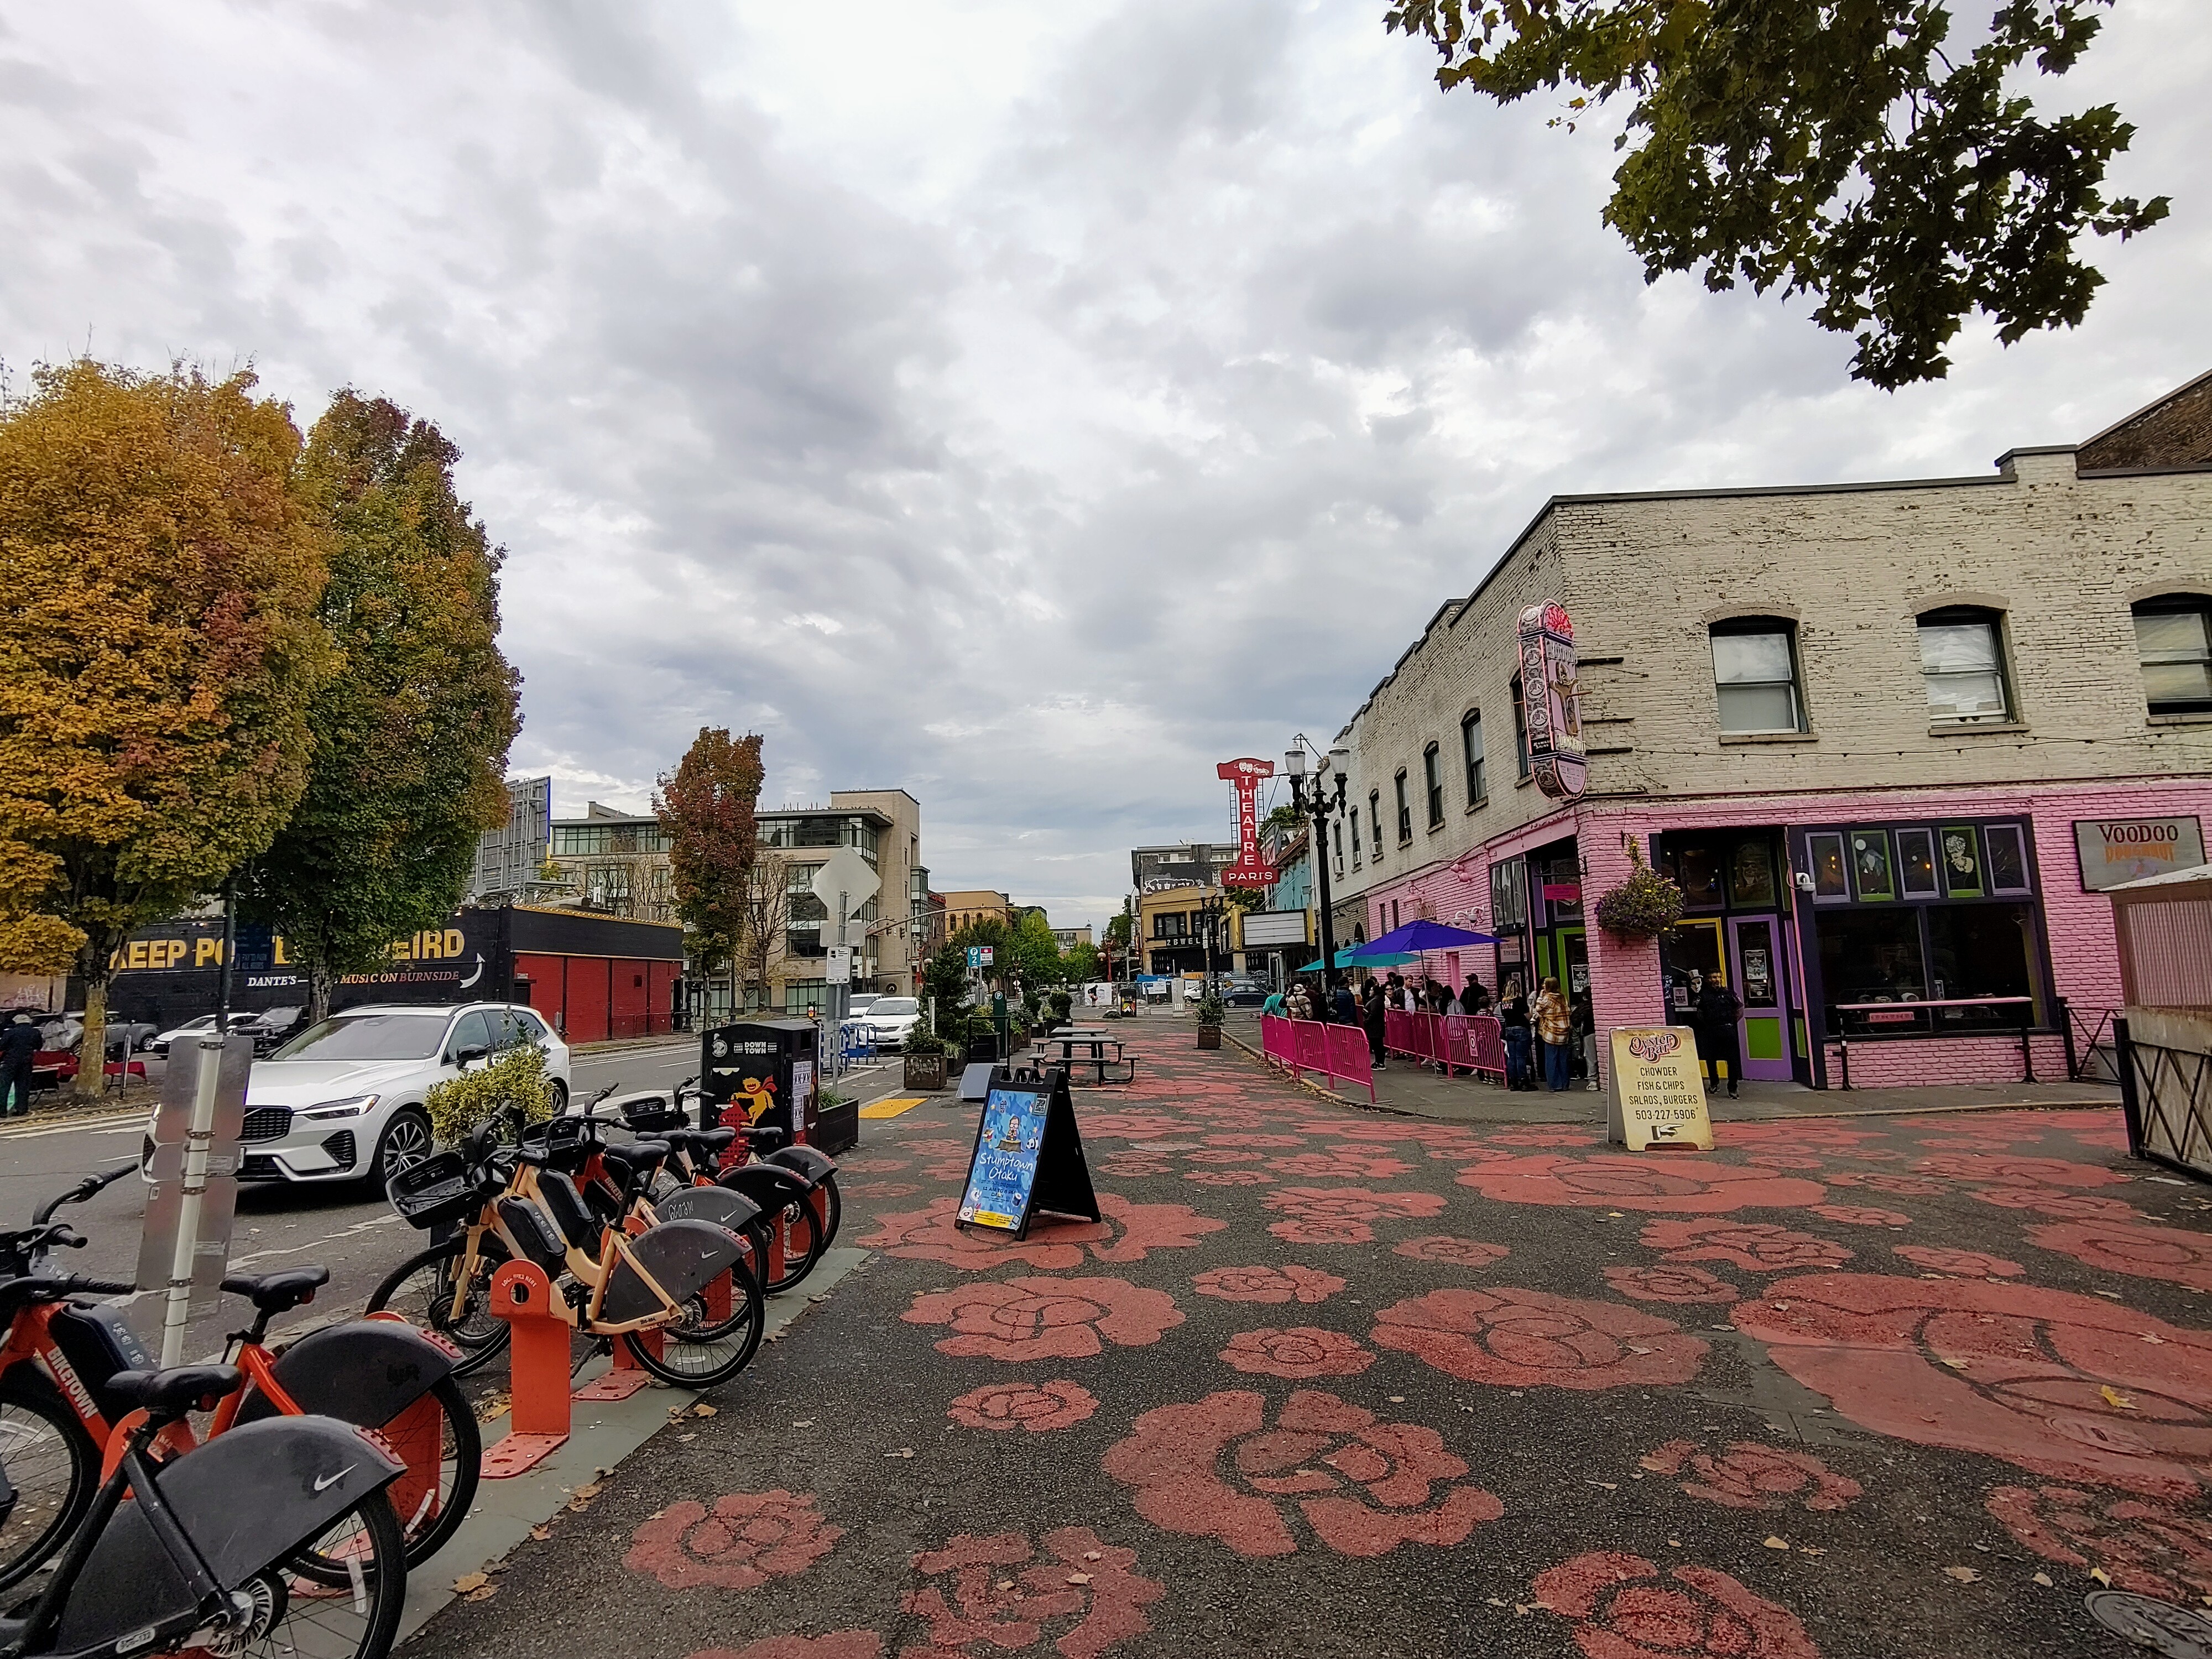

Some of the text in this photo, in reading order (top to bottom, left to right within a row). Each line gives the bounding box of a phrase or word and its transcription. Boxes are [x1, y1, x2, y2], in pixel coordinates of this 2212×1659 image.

[1241, 775, 1255, 866] THEATRE
[2096, 823, 2179, 844] VOODOO
[2105, 843, 2175, 864] DOUGHNUT
[1228, 871, 1273, 881] PARIS
[247, 971, 460, 987] DANTE'S MUSIC ON BURNSIDE
[1629, 1033, 1679, 1056] Oyster
[1645, 1044, 1671, 1062] Bar
[1640, 1067, 1678, 1076] CHOWDER
[1637, 1081, 1685, 1090] FISH & CHIPS
[1629, 1095, 1698, 1106] SALADS, BURGERS
[1636, 1109, 1696, 1120] 503-227-5906
[979, 1152, 1033, 1171] Stumptown
[989, 1166, 1018, 1182] Otaku
[604, 1176, 624, 1202] BIKETO
[46, 1345, 100, 1419] BIKETOWN
